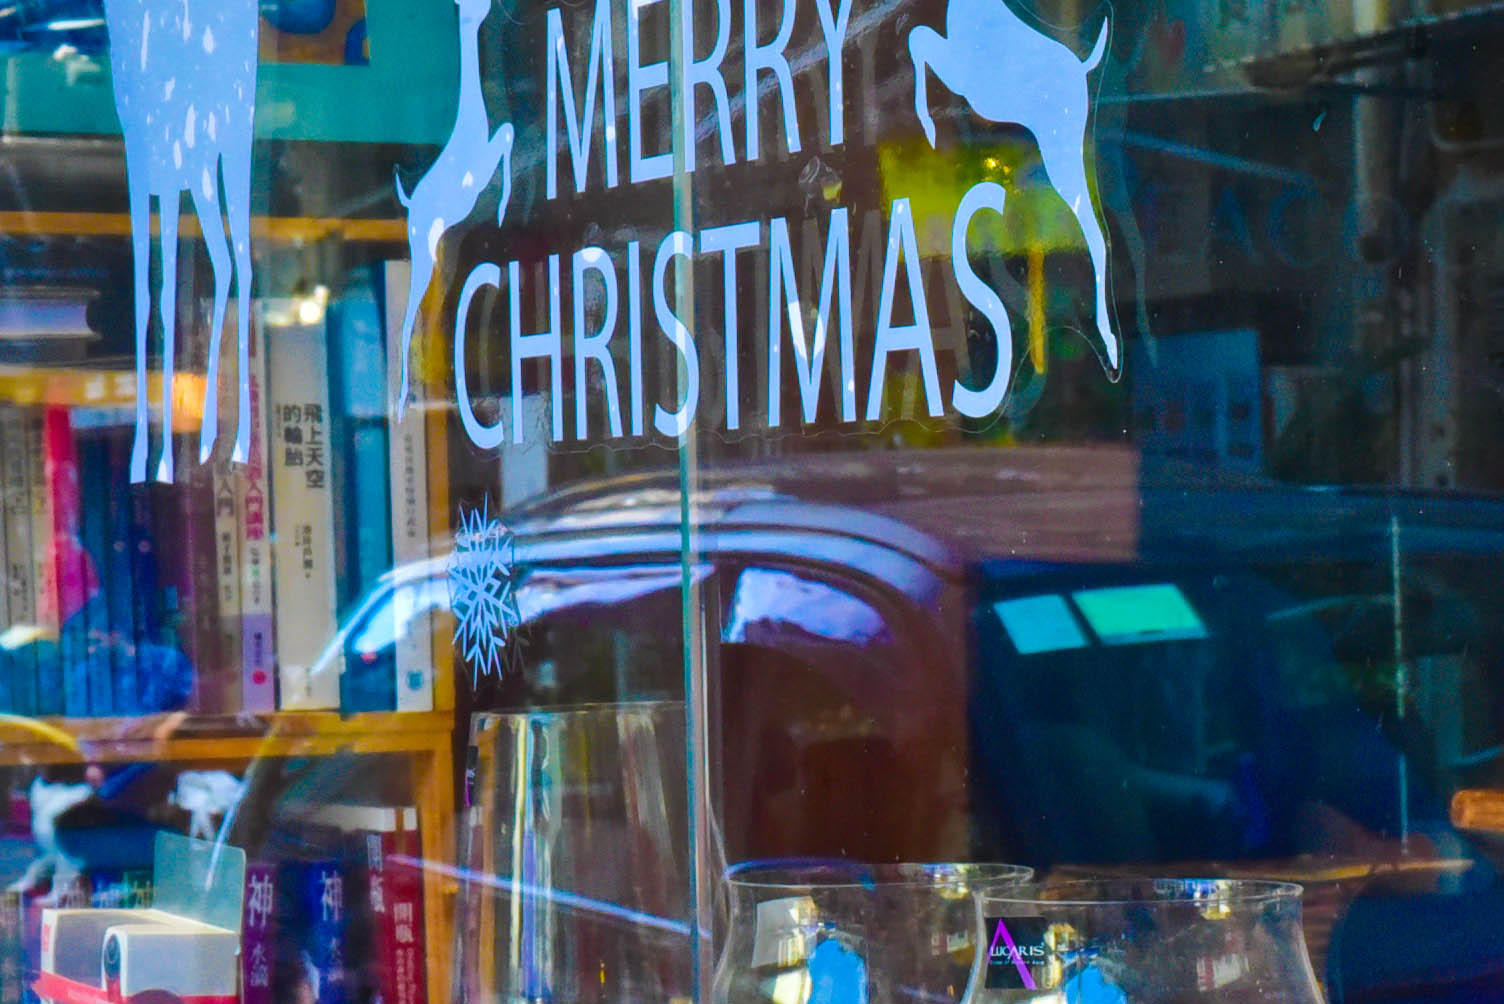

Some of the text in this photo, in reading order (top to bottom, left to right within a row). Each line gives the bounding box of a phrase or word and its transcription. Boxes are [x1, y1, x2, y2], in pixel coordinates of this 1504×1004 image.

[546, 0, 852, 200] MERRY
[454, 181, 1013, 450] CHRISTMAS
[302, 402, 326, 489] 飛上天空
[989, 945, 1045, 960] LUCARIS
